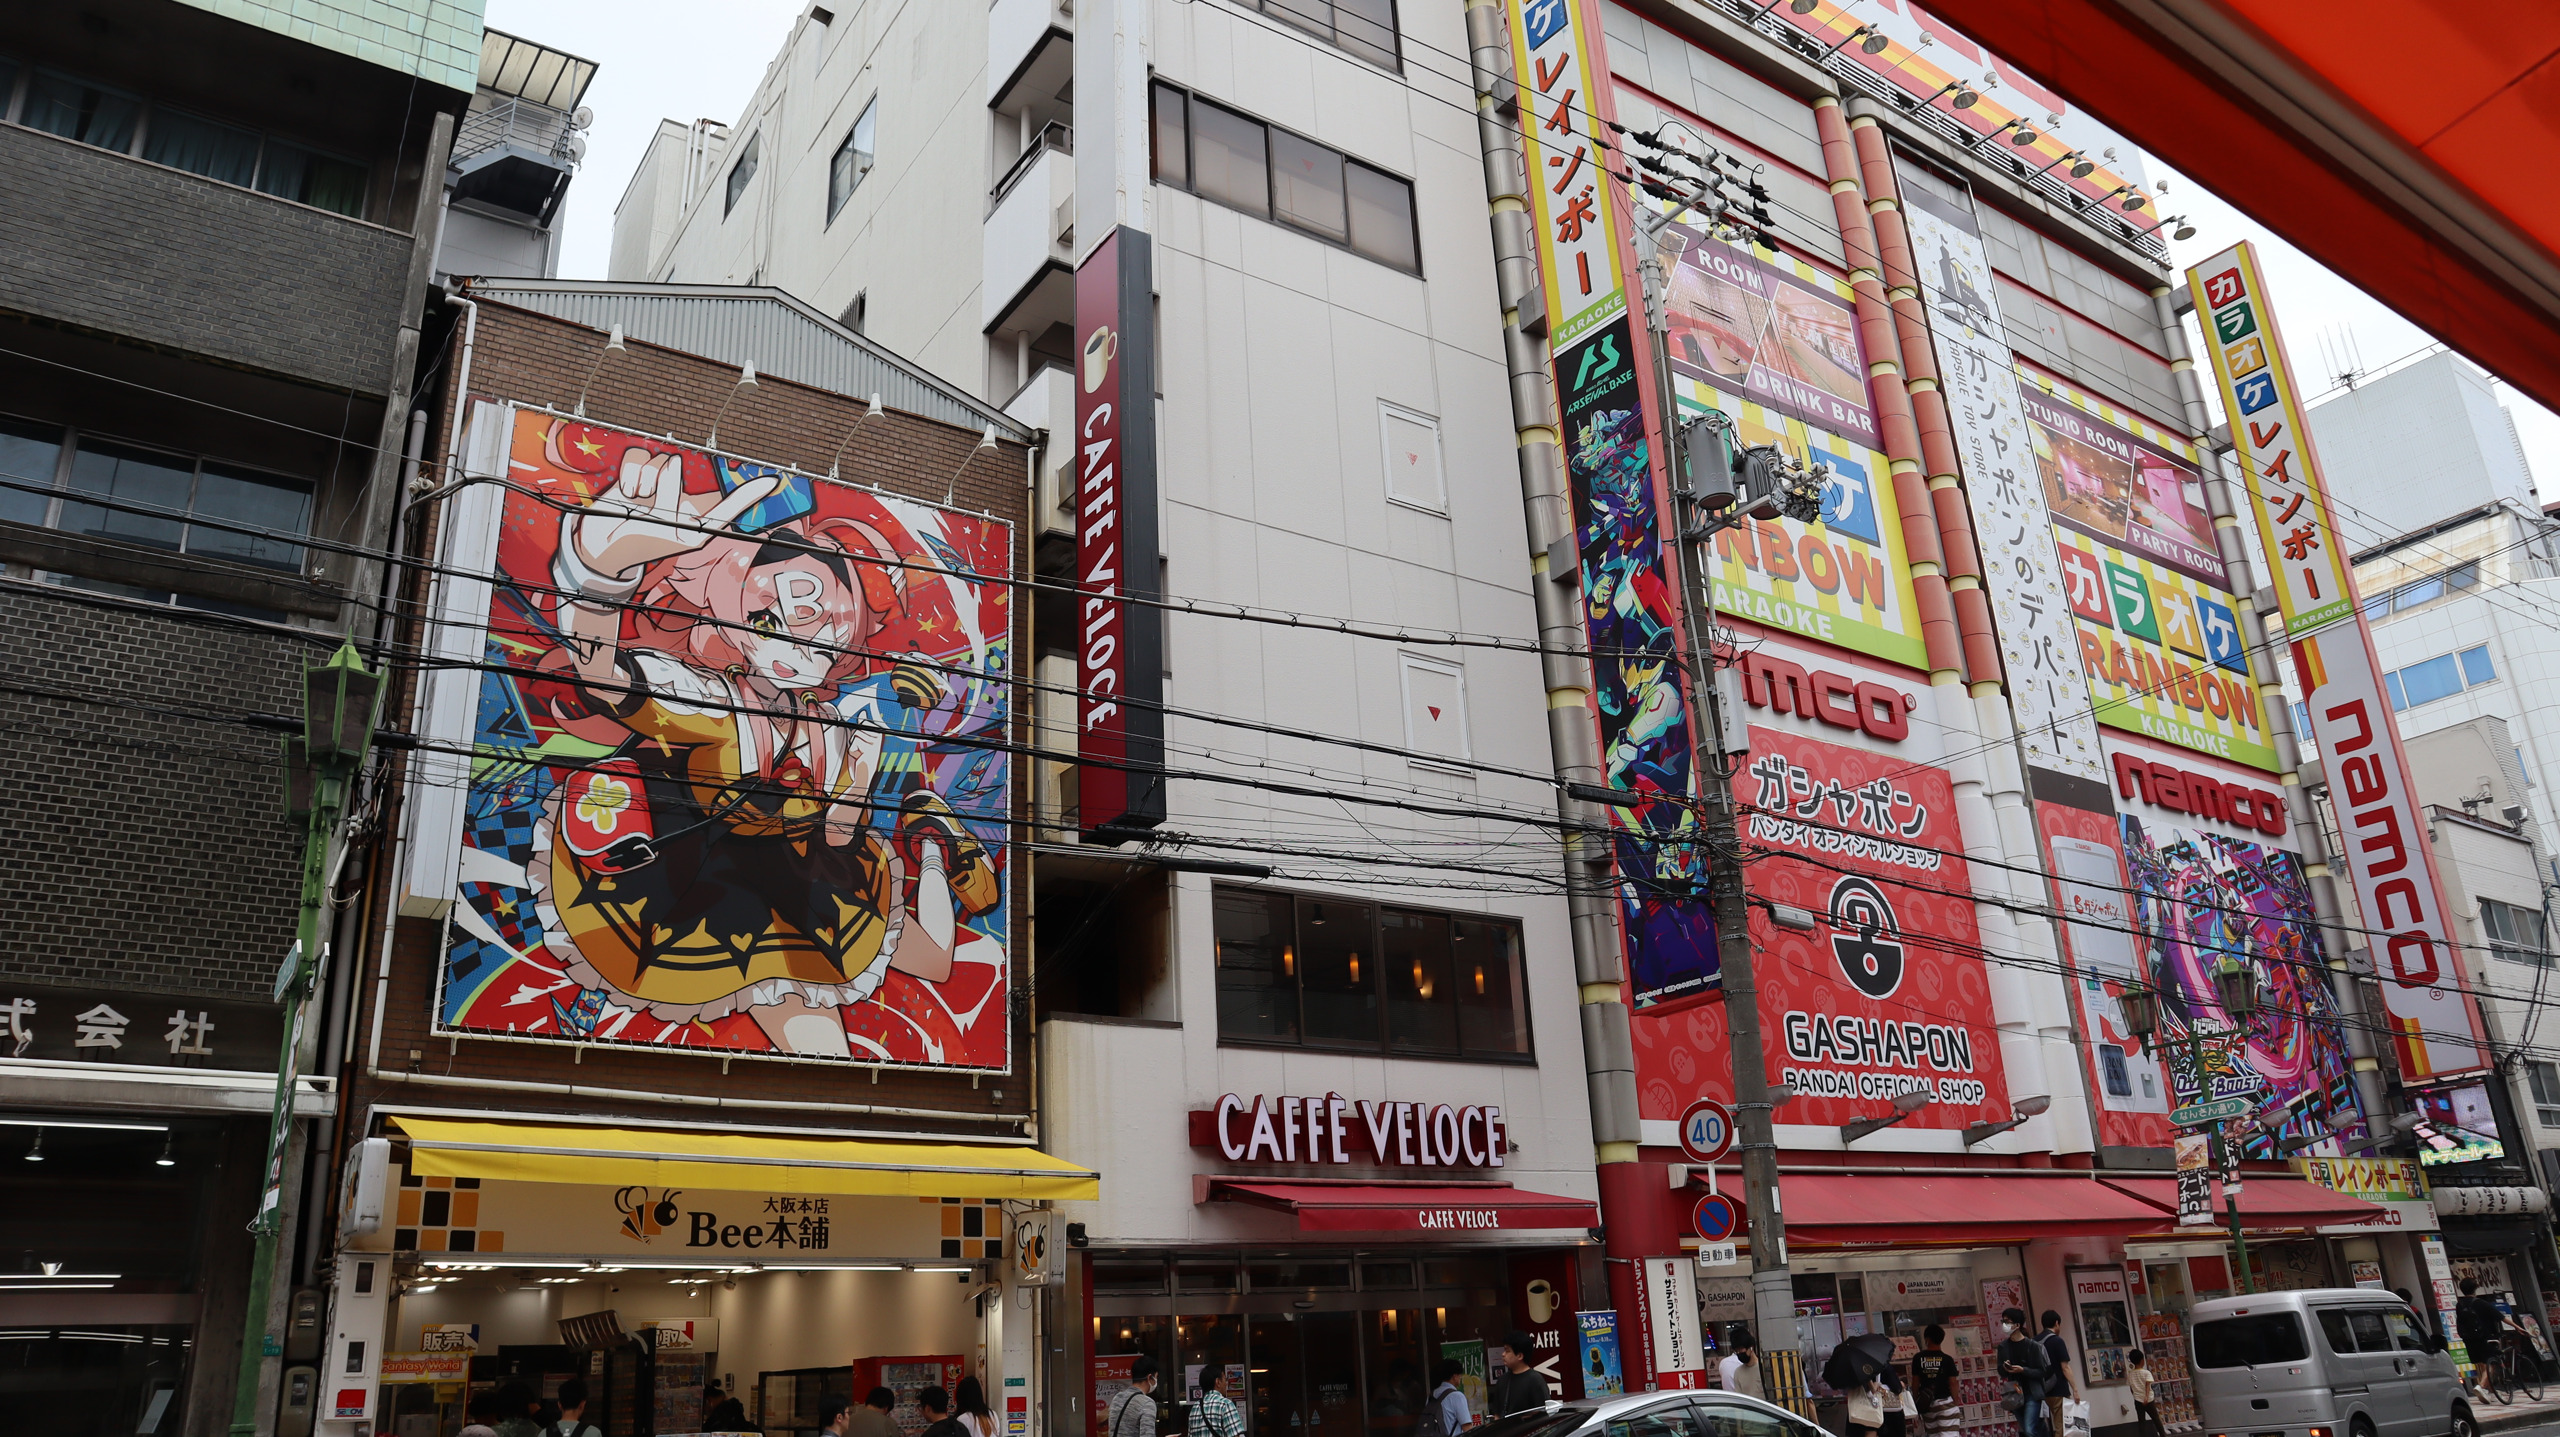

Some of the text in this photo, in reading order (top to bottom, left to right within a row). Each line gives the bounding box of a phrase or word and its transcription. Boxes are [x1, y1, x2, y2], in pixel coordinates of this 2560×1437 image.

[1697, 249, 1763, 291] ROOM
[1558, 293, 1624, 341] KARAOKE
[1608, 368, 1634, 391] BASE
[1754, 369, 1875, 436] DRINK BAR
[1946, 339, 1989, 480] CAPSULE TOY STORE
[2021, 400, 2130, 460] STUDIO ROOM
[2210, 274, 2322, 600] カラオケ レインボー
[1965, 344, 2068, 755] ガシャポンのデパート
[2132, 526, 2225, 579] PARTY ROOM
[1714, 583, 1834, 640] ARAOKE
[2066, 554, 2235, 658] カラオケ
[2292, 602, 2351, 630] KARAOKE
[1084, 547, 1120, 732] VELOCE
[2077, 628, 2259, 731] RAINBOW
[2140, 713, 2231, 758] KARAOKE
[1751, 754, 1925, 837] ガシャポン
[1750, 814, 1942, 871] バンダイ オフィシャルショップ
[1786, 1013, 1971, 1071] GASHAPON
[1785, 1068, 1985, 1106] BANDAI OFFICIAL SHOP
[1692, 1117, 1722, 1145] 40
[2179, 1102, 2237, 1121] なんさん通り
[1356, 1099, 1505, 1169] VELOCE
[2178, 1172, 2208, 1191] フード
[2179, 1184, 2212, 1203] ホール
[2333, 1162, 2402, 1190] レインボー
[2357, 1192, 2388, 1201] KARAOKE
[763, 1197, 829, 1214] 大阪本店
[1457, 1210, 1499, 1229] VELOCE
[686, 1211, 829, 1250] Bee本舗
[1700, 1248, 1735, 1264] 自動車
[1633, 1258, 1648, 1331] ドラゴンスター
[1708, 1292, 1746, 1302] GASHAPON
[2078, 1281, 2120, 1294] namco
[423, 1331, 464, 1352] 販売
[1580, 1312, 1616, 1329] ふちねこ
[1664, 1279, 1680, 1368] サテライトショップ
[427, 1360, 461, 1371] World
